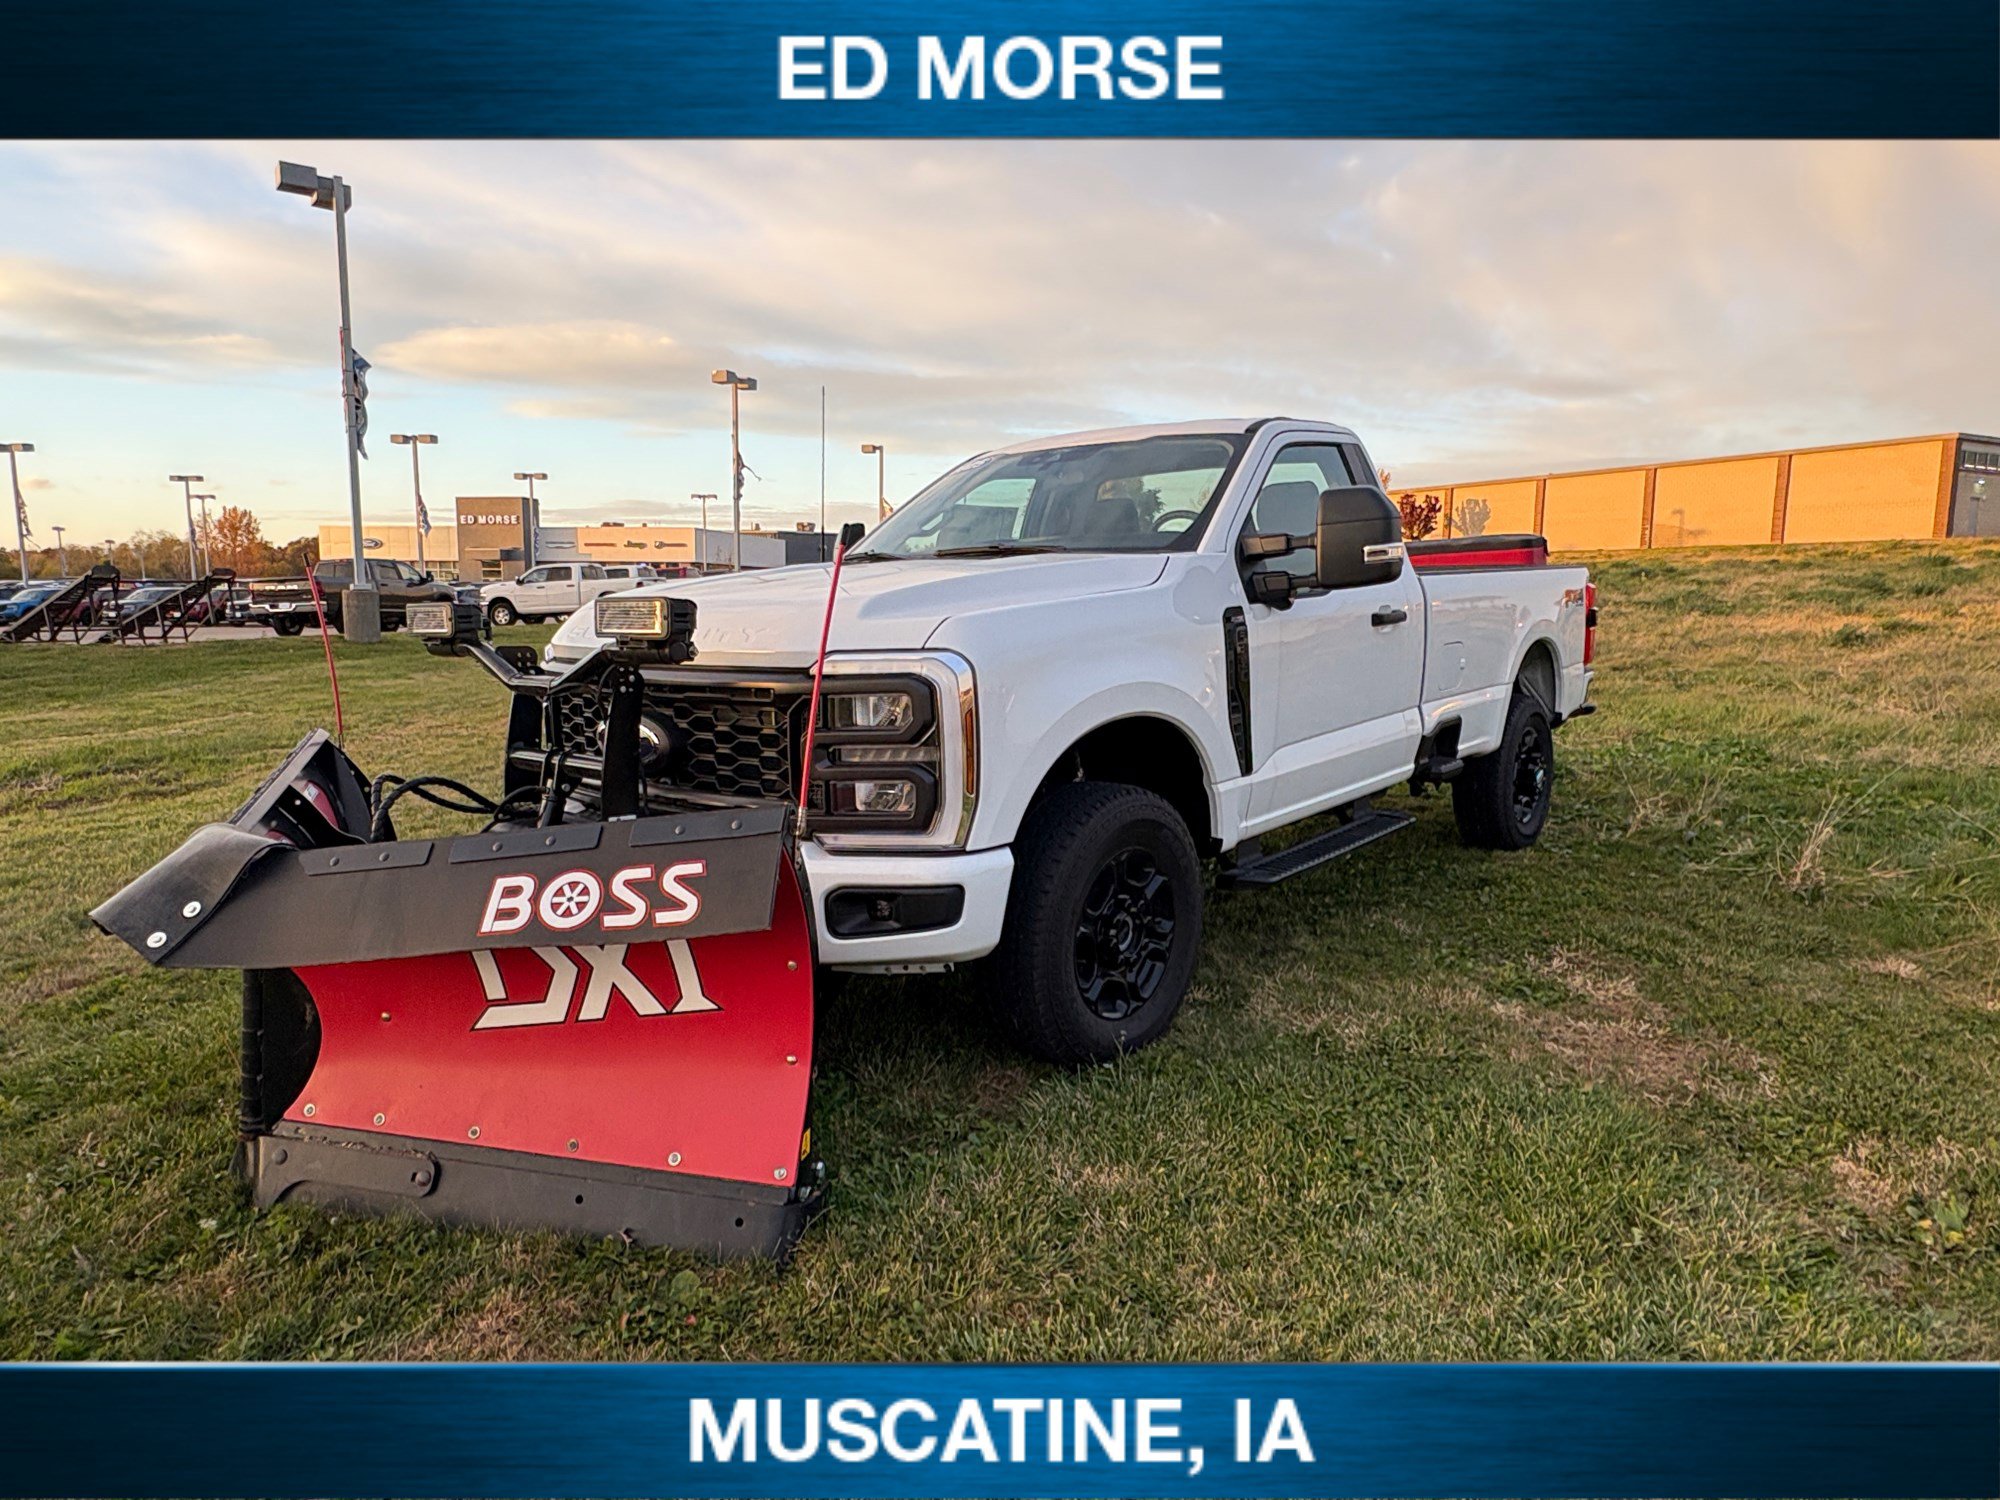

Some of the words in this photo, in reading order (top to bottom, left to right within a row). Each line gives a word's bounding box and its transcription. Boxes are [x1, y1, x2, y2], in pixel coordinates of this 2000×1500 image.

[460, 514, 475, 525] ED
[478, 514, 518, 525] MORSE
[478, 860, 706, 936] BOSS
